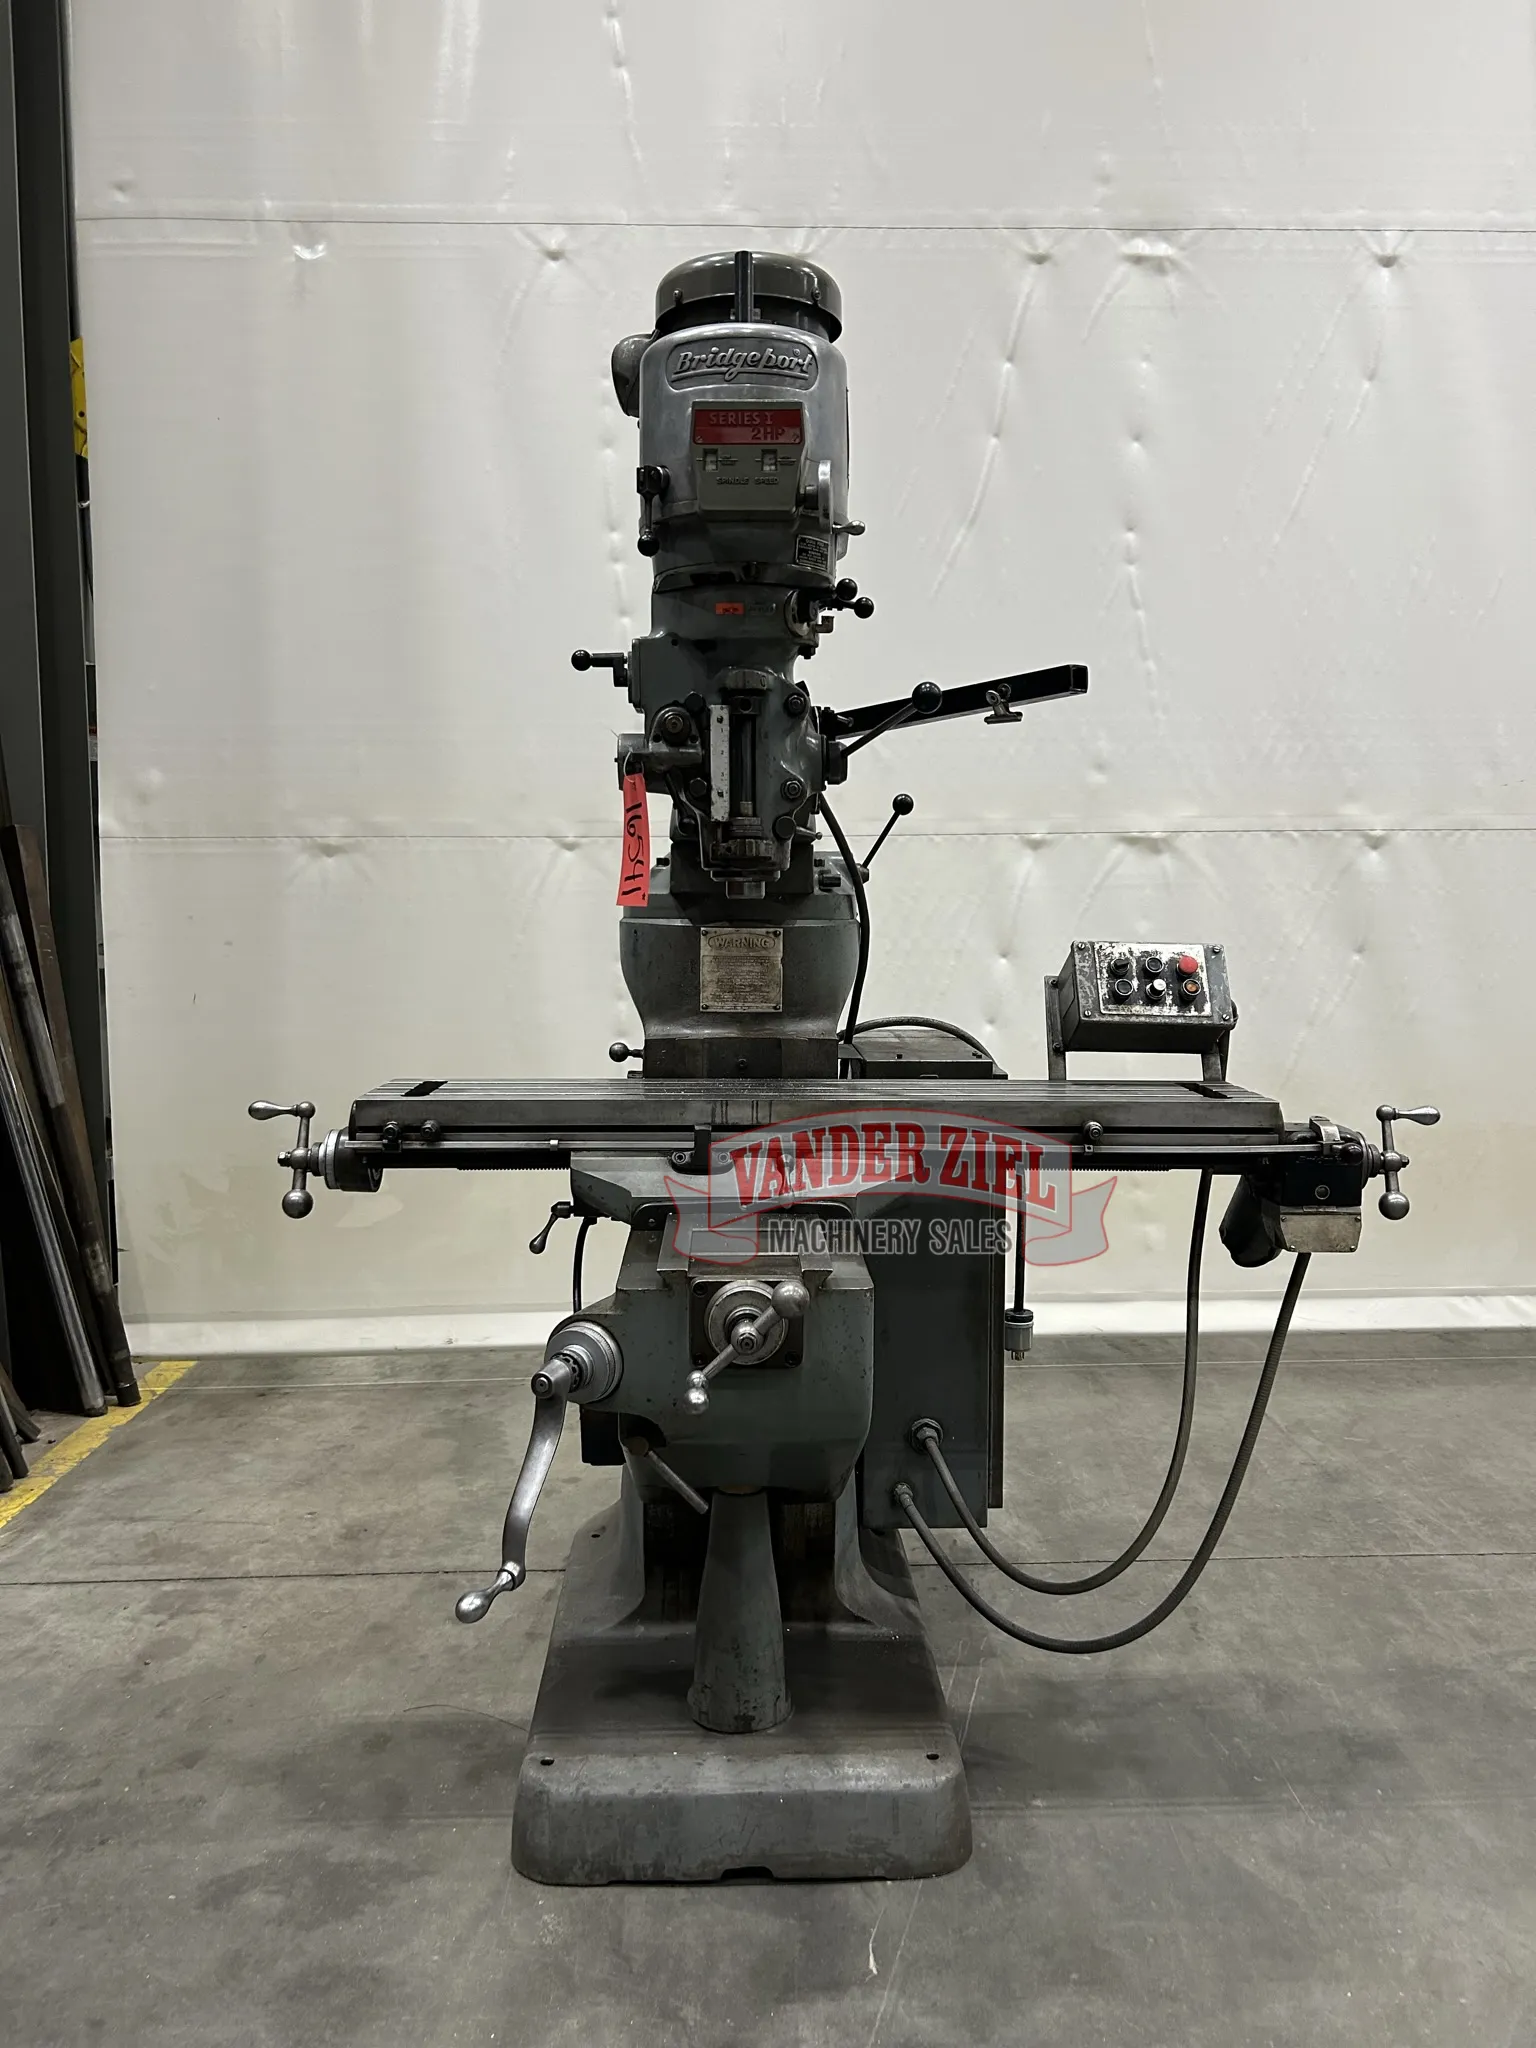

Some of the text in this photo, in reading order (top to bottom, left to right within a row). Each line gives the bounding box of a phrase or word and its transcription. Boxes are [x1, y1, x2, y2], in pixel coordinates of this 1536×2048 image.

[673, 346, 812, 381] Bridgeport
[709, 411, 760, 425] SERIES
[751, 426, 786, 441] 2HP
[716, 476, 780, 486] SPINDLE SPEED
[620, 801, 645, 896] 16541
[714, 936, 770, 949] WARNING
